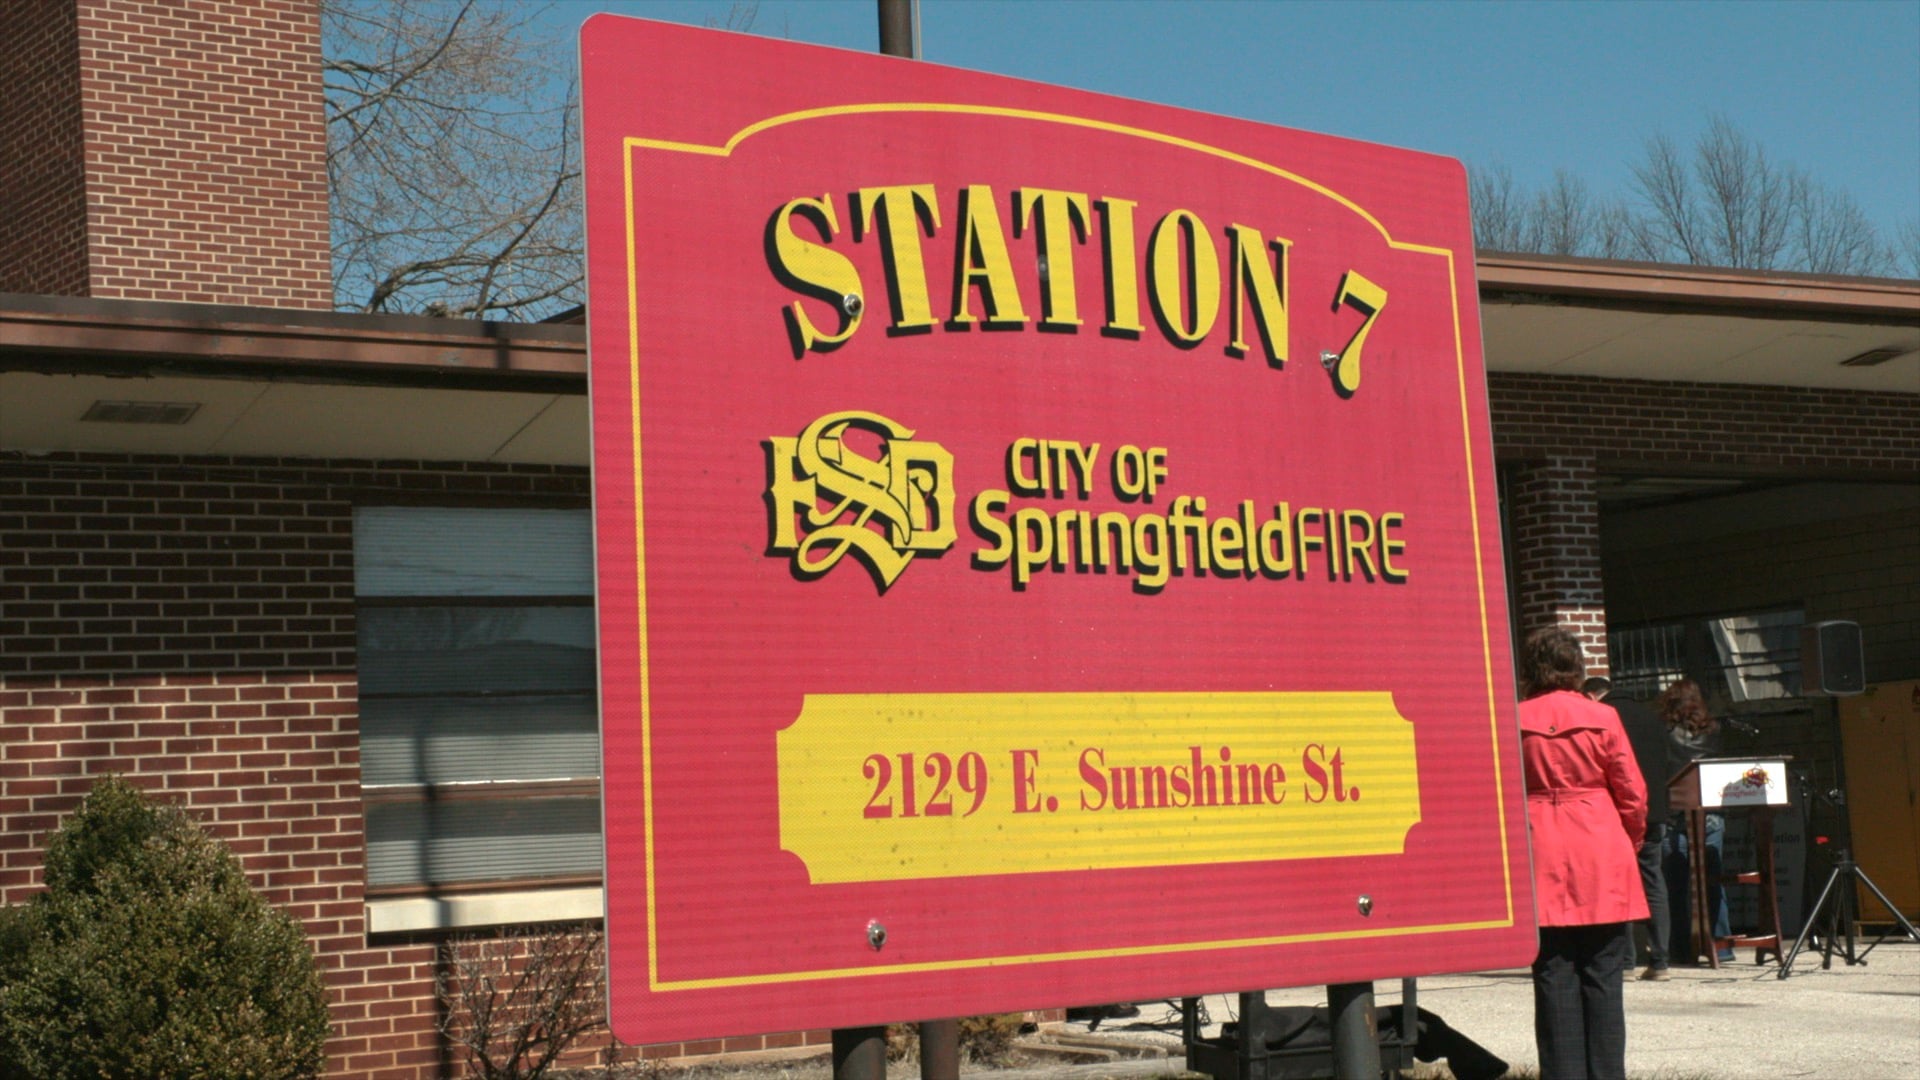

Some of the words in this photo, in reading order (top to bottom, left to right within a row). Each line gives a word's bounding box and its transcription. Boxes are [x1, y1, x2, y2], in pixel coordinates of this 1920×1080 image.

[766, 184, 1294, 368] STATION
[1331, 269, 1388, 398] 7
[1006, 437, 1101, 500] CITY
[1111, 444, 1169, 502] OF
[862, 752, 988, 820] 2129
[1009, 749, 1059, 814] E.
[1079, 746, 1287, 812] Sunshine
[1302, 743, 1361, 804] St.
